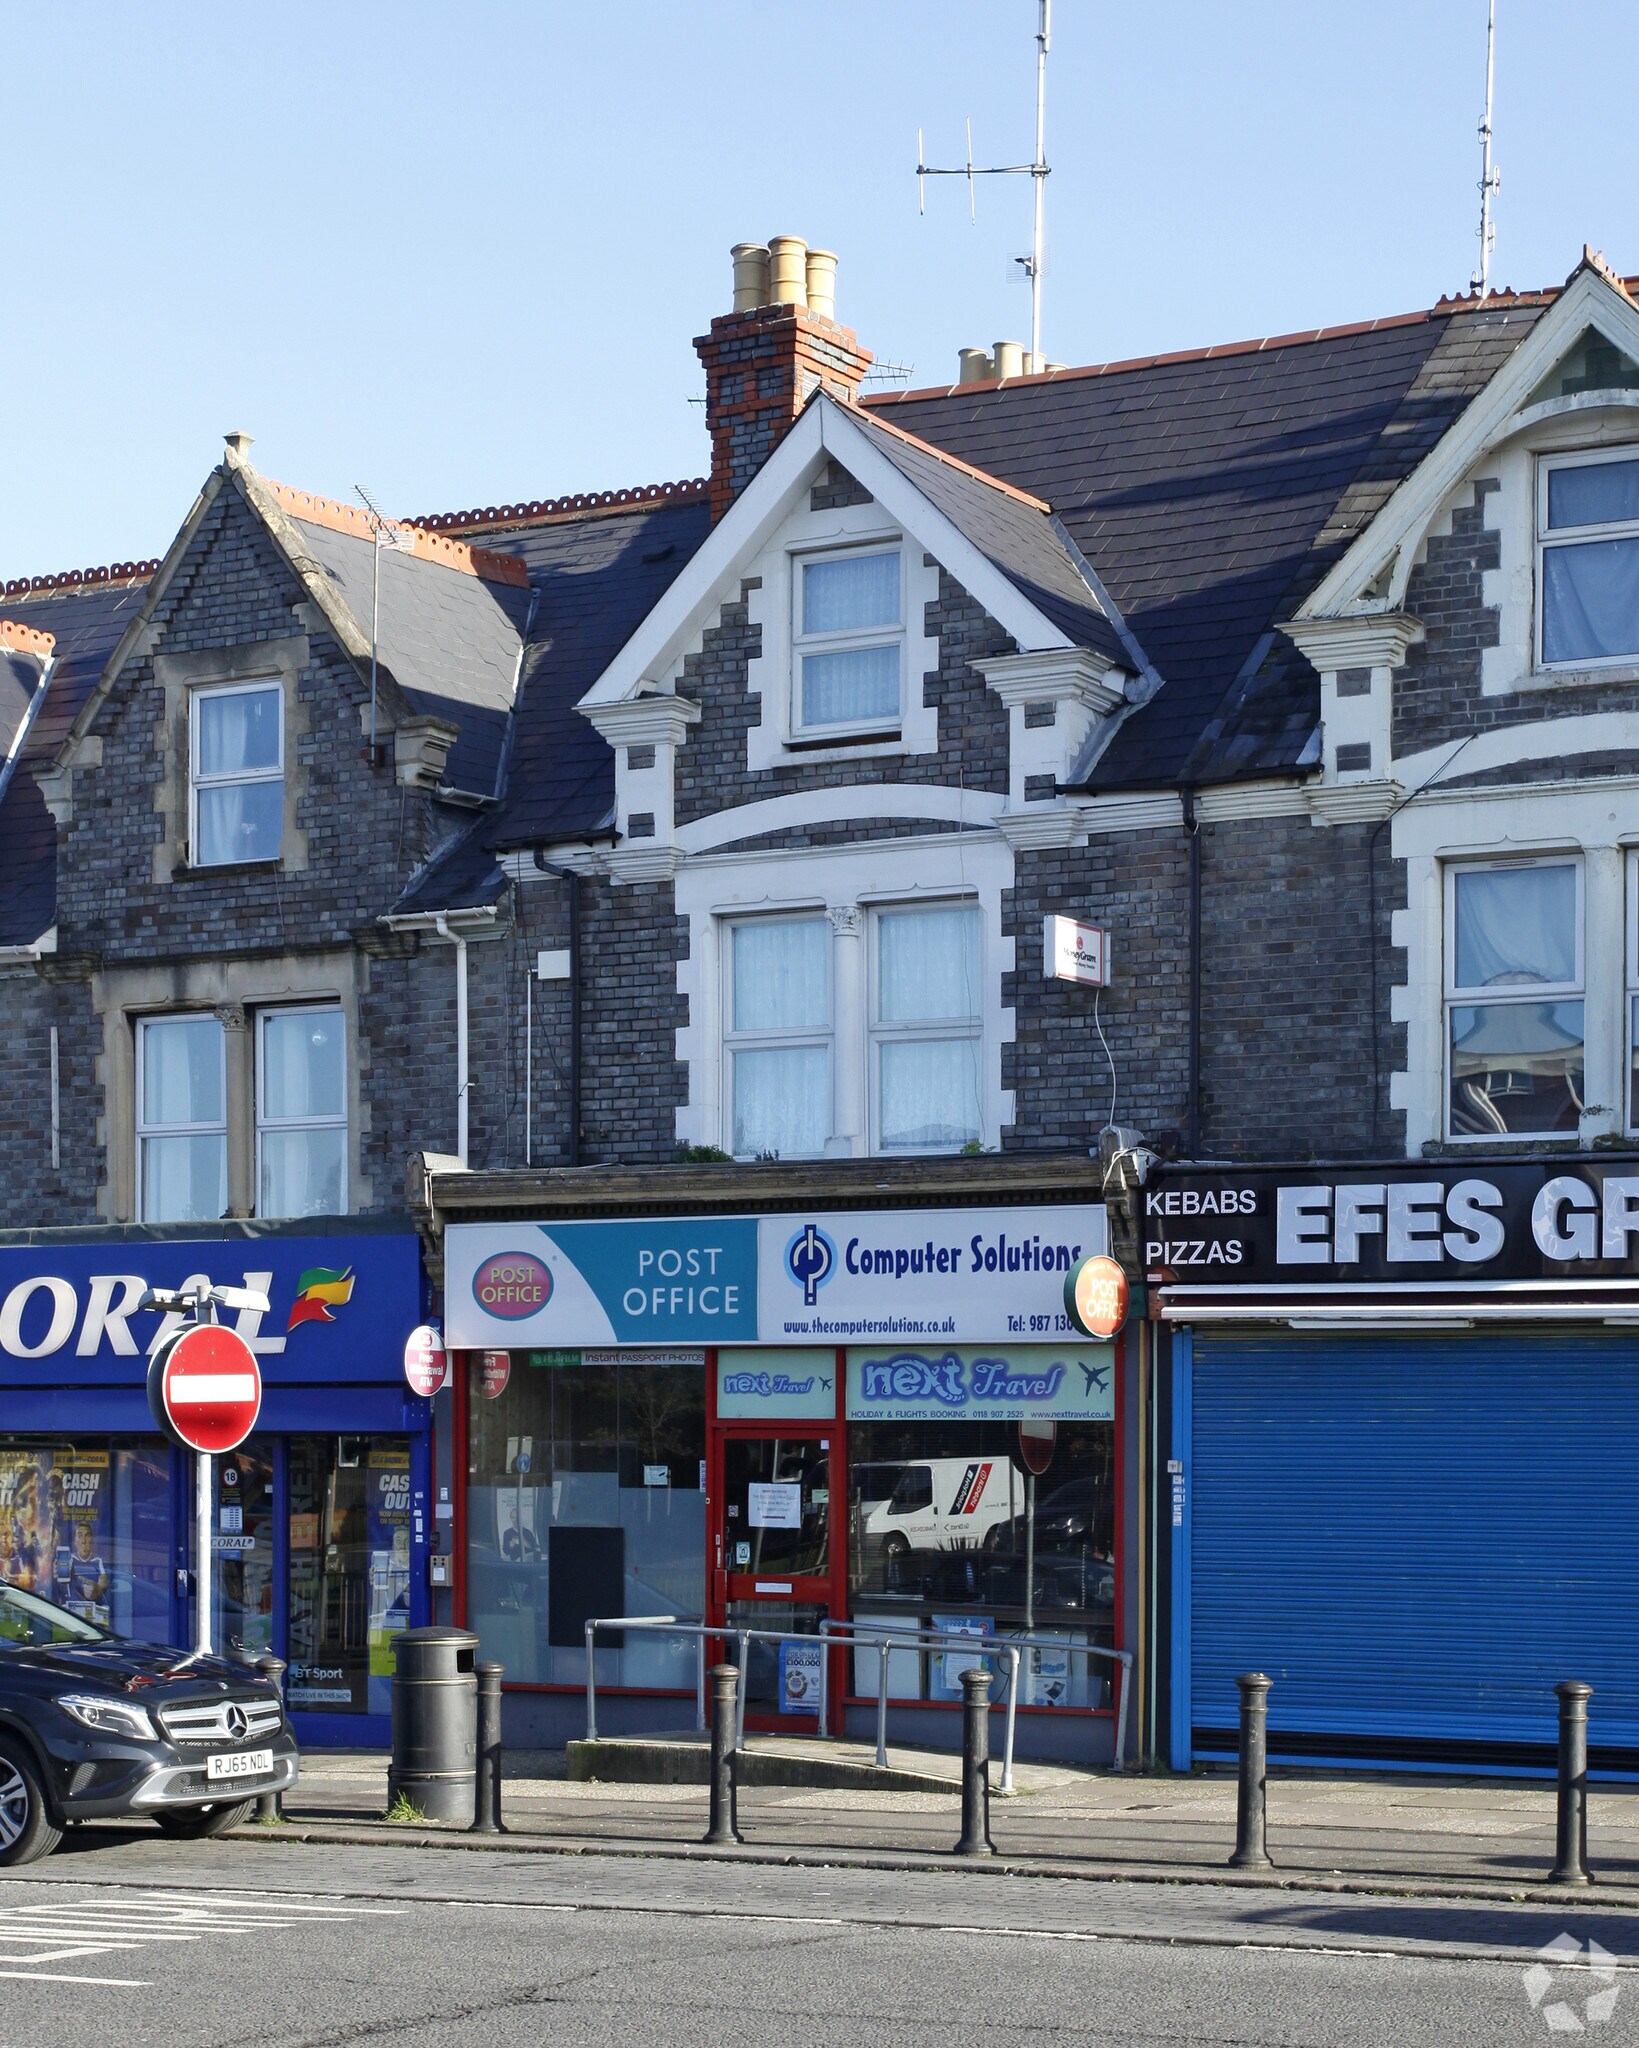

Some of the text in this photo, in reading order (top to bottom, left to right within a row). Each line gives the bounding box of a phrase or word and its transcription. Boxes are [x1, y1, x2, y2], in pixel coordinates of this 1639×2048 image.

[1146, 1189, 1257, 1216] KEBABS
[1276, 1178, 1505, 1264] EFES
[845, 1237, 962, 1279] Computer
[1146, 1239, 1243, 1265] PIZZAS
[639, 1247, 723, 1278] POST
[490, 1267, 535, 1284] POST
[481, 1286, 542, 1303] OFFICE
[1091, 1279, 1120, 1299] POST
[623, 1285, 739, 1316] OFFICE
[1085, 1299, 1123, 1320] OFFICE
[783, 1315, 956, 1335] www.thecomputersolutions.co.uk
[1007, 1315, 1026, 1332] Tel:
[1029, 1315, 1051, 1331] 987
[585, 1352, 619, 1362] Instant
[621, 1353, 667, 1362] PASSPORT
[668, 1353, 704, 1362] PHOTOS
[725, 1373, 814, 1395] next Travel
[865, 1357, 1063, 1401] next Travel
[851, 1410, 883, 1418] HOLIDAY
[895, 1410, 928, 1418] FLIGHTS
[931, 1410, 967, 1418] BOOKING
[973, 1410, 988, 1418] 0118
[991, 1410, 1004, 1418] 907
[1007, 1410, 1025, 1418] 2525
[1031, 1410, 1112, 1419] www.nexttravel.co.uk
[62, 1473, 100, 1490] CASH
[67, 1490, 95, 1507] OUT
[313, 1667, 343, 1680] Sport
[215, 1752, 269, 1774] RJ65 NDL
